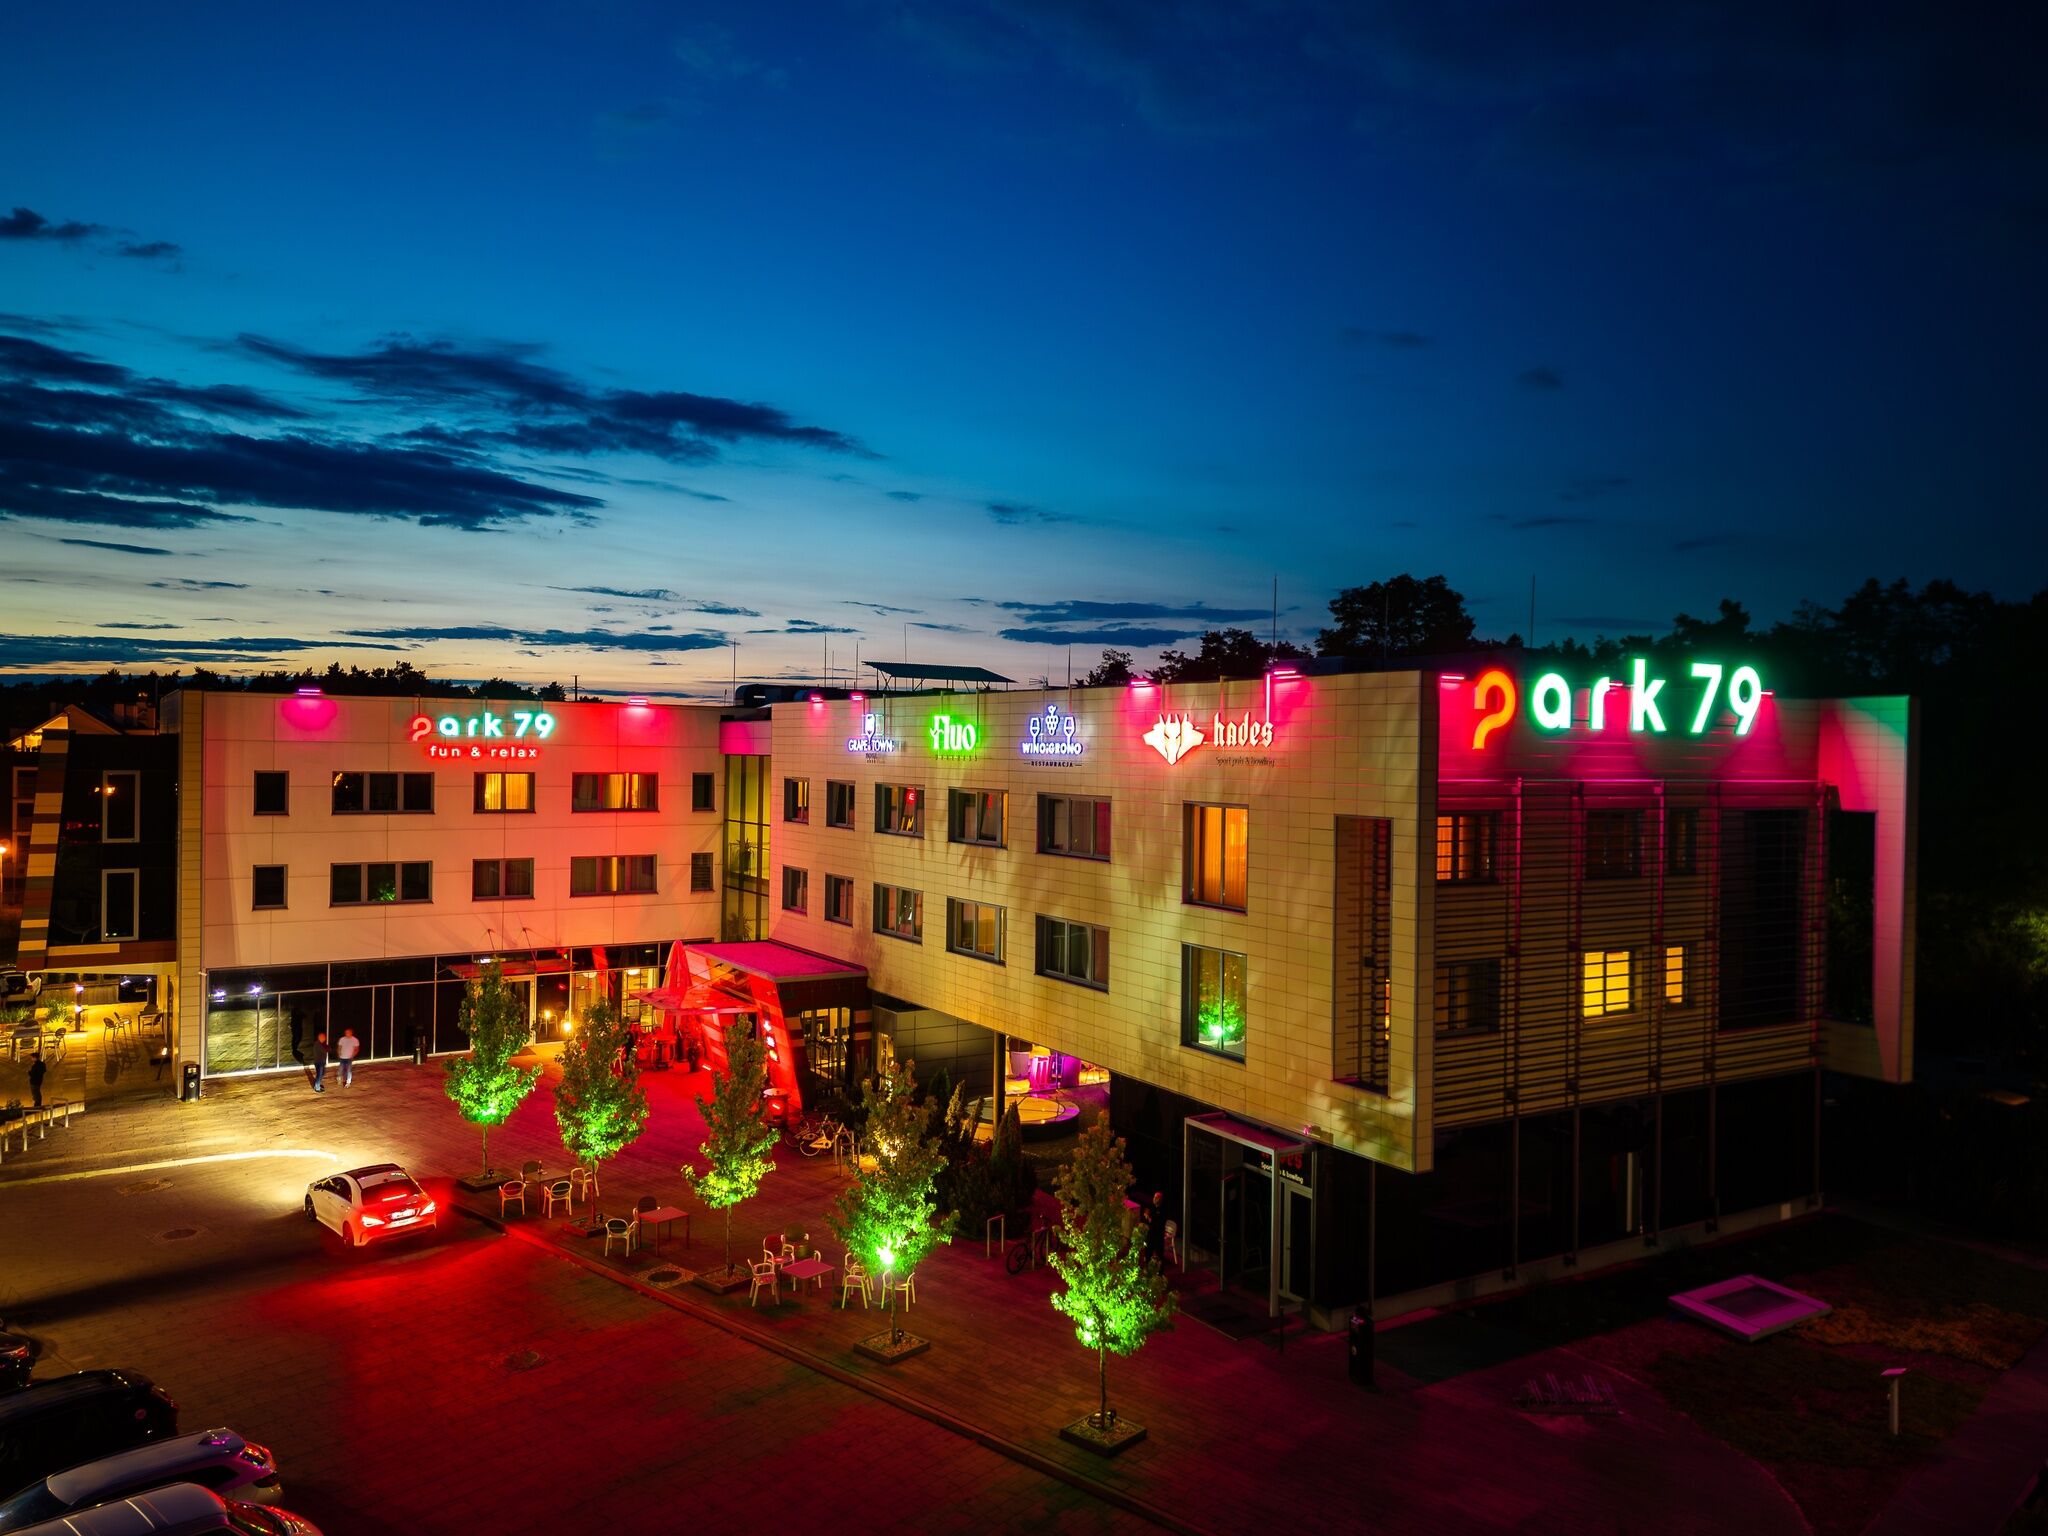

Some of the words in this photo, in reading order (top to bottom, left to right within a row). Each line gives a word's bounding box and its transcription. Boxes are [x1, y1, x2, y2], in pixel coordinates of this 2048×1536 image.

[1691, 662, 1762, 735] 79
[513, 712, 555, 738] 79
[430, 745, 461, 757] fun
[471, 746, 481, 758] &
[491, 746, 537, 758] relax
[871, 739, 893, 752] TOWN
[1031, 760, 1074, 768] RESTAURACJA
